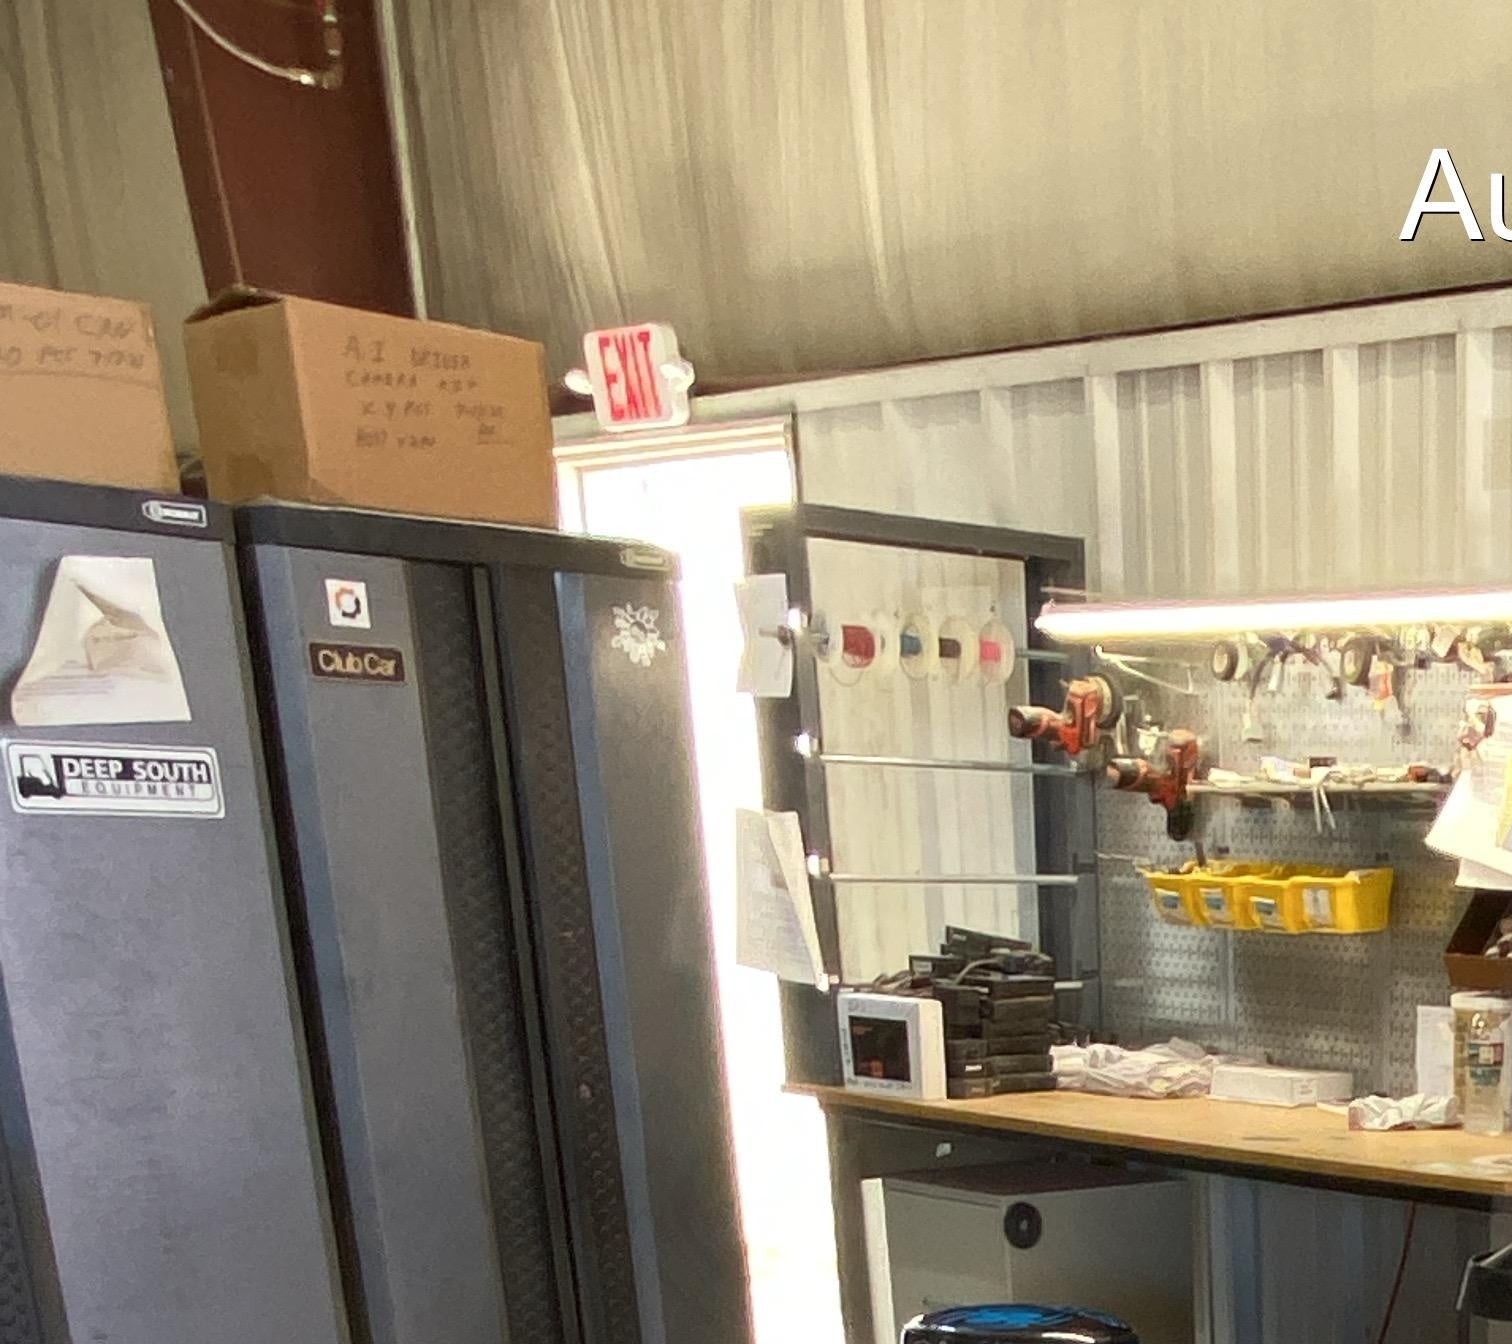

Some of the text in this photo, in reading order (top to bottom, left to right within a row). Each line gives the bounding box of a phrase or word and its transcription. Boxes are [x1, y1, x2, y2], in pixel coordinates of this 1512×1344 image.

[598, 331, 663, 422] EXIT
[318, 649, 397, 677] Club Car
[62, 757, 210, 782] DEEP SOUTH
[81, 780, 197, 798] EQUIPMENT
